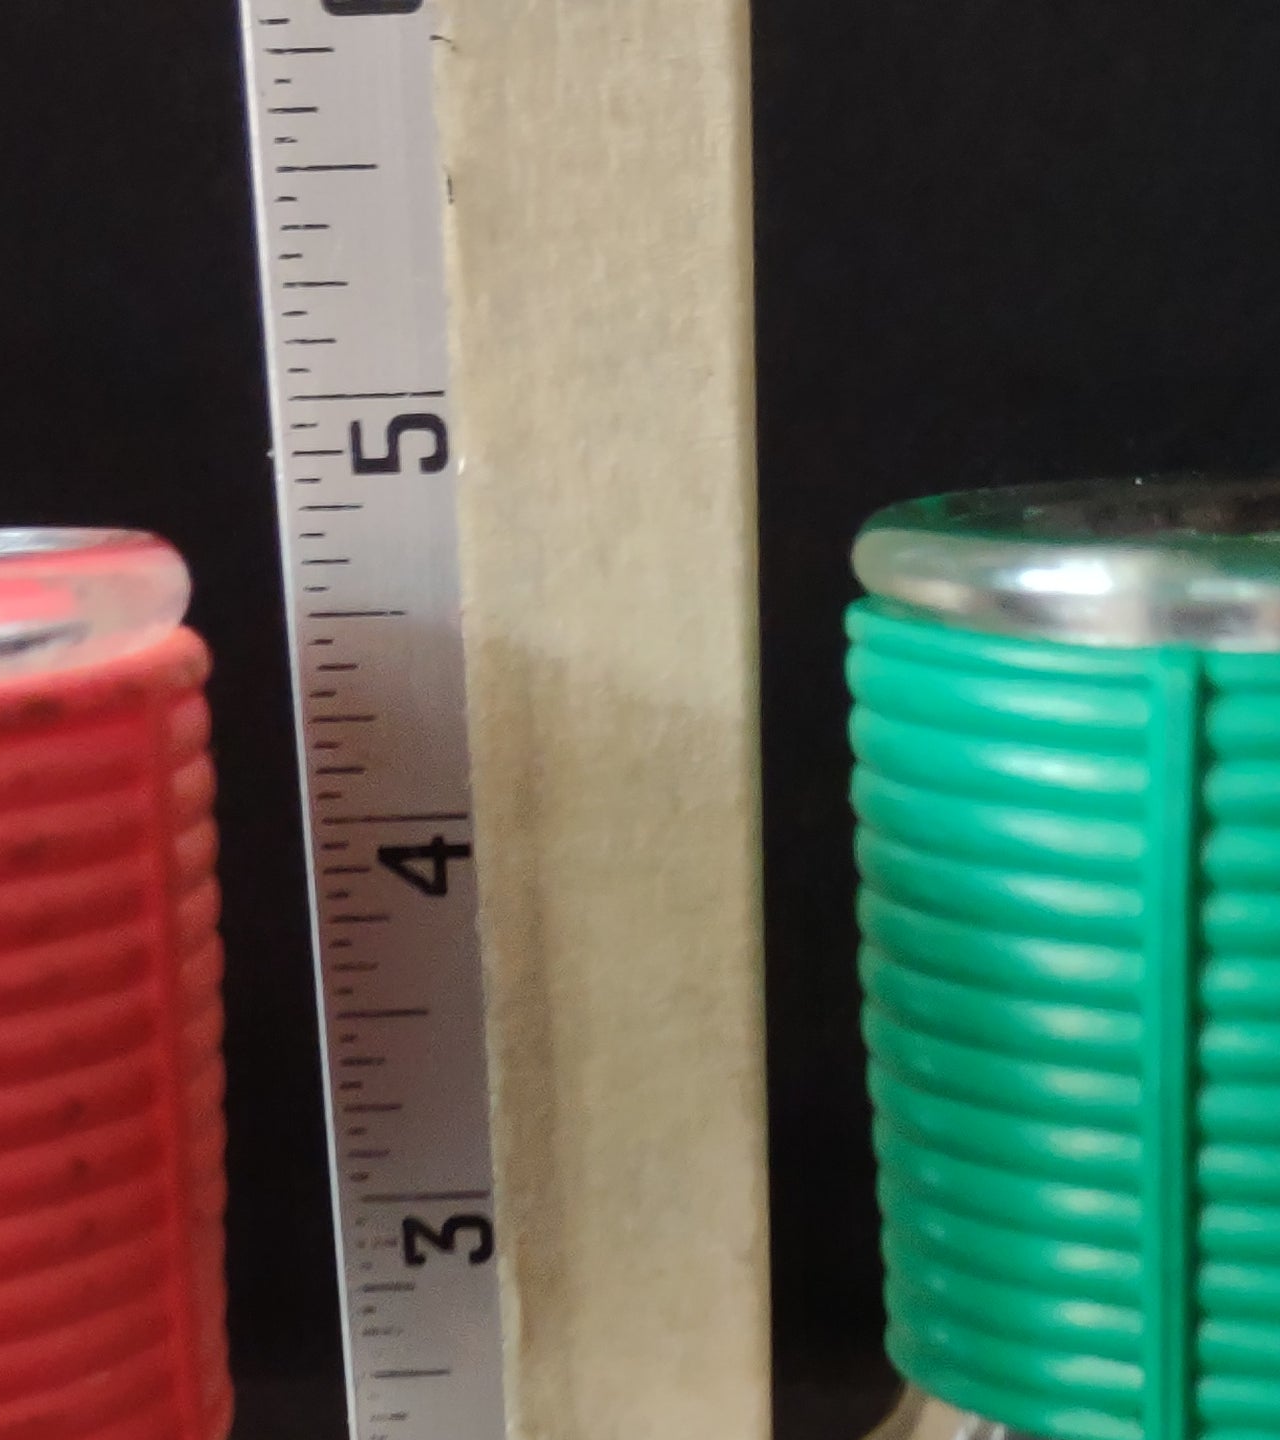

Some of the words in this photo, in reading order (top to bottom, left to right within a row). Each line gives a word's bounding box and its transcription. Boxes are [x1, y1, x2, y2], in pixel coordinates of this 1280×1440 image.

[350, 412, 449, 476] 5
[377, 835, 472, 897] 4
[402, 1213, 496, 1266] 3
